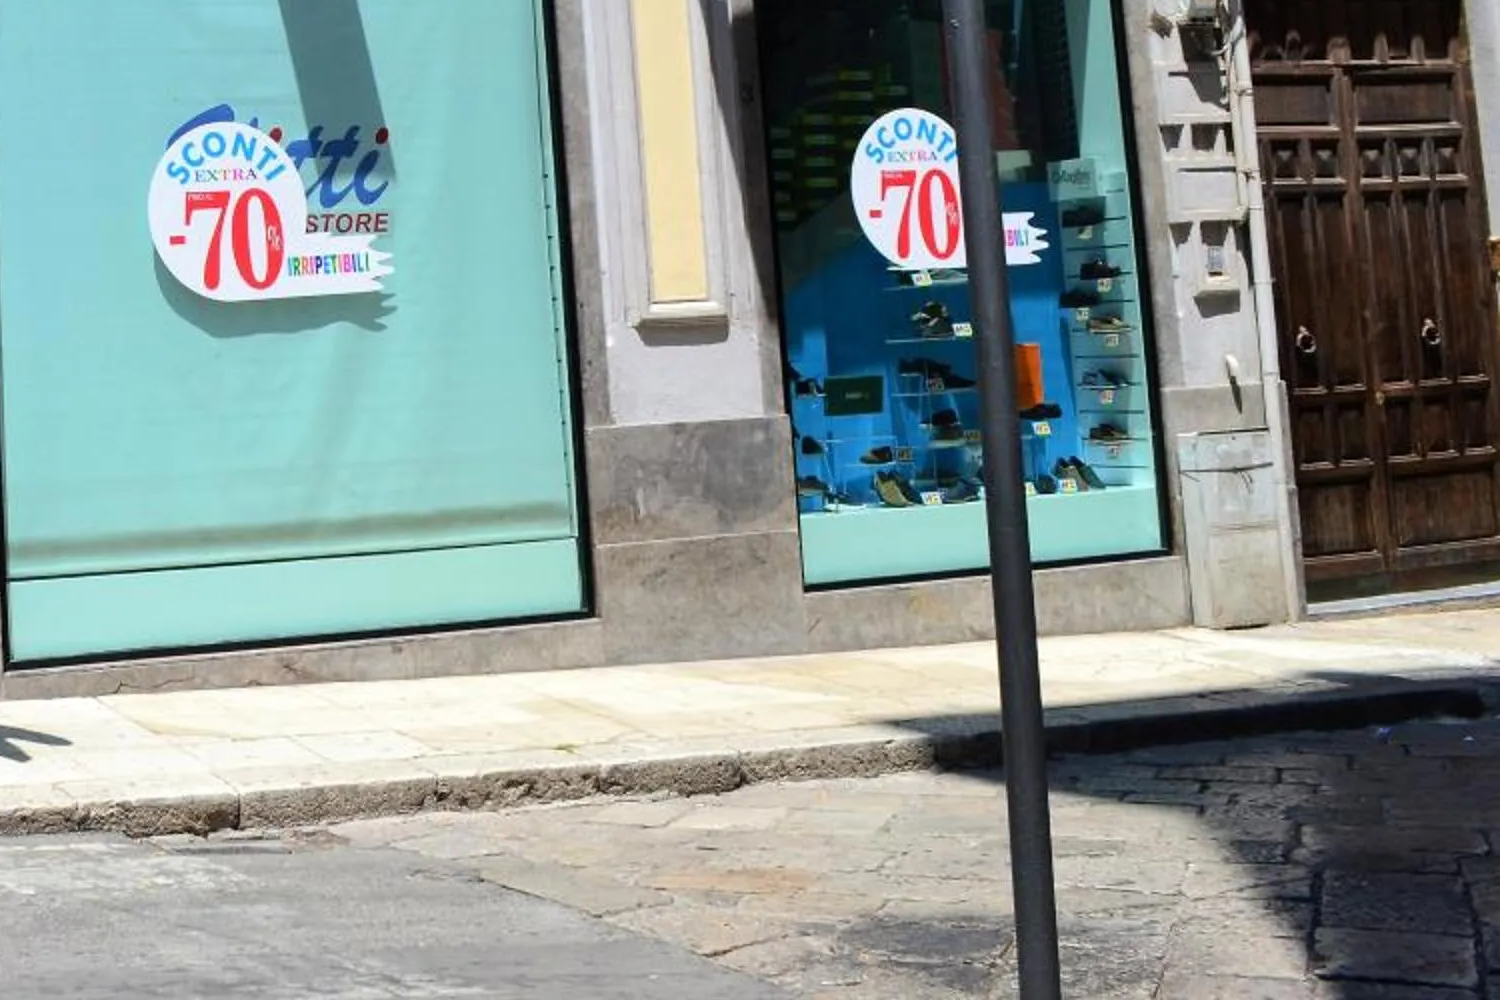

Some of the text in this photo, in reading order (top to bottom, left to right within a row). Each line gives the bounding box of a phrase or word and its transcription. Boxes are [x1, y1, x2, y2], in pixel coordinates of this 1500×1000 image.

[167, 132, 287, 186] SCONTI
[887, 149, 939, 163] EXTRA
[195, 168, 259, 183] EXTRA
[305, 213, 389, 234] STORE
[288, 251, 371, 277] IRRIPETIBILI
